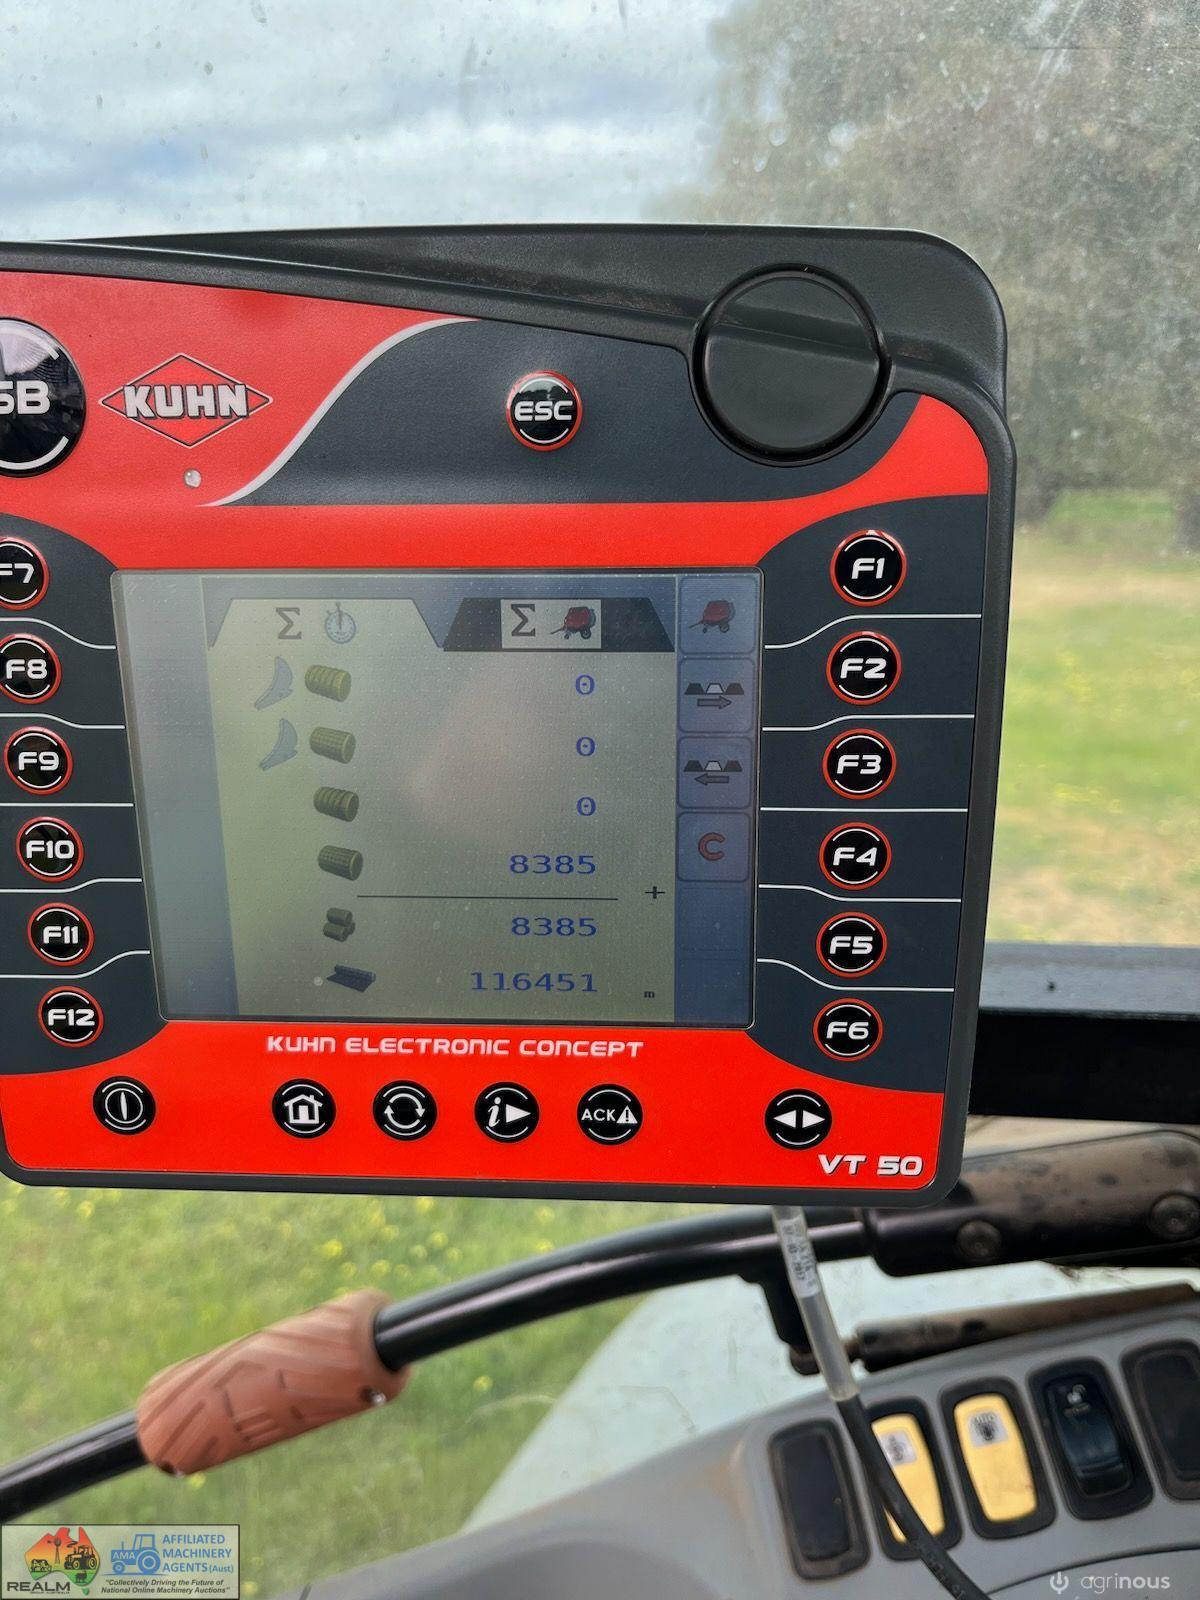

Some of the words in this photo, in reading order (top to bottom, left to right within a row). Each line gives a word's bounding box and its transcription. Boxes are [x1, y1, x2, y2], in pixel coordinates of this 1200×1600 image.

[123, 384, 249, 418] KUHN
[514, 400, 573, 422] ESC
[851, 557, 886, 579] F1
[6, 659, 47, 680] F8
[839, 658, 887, 679] F2
[575, 674, 595, 695] 0
[576, 736, 596, 757] 0
[18, 751, 59, 771] F9
[836, 754, 882, 775] F3
[576, 796, 597, 817] 0
[26, 839, 75, 859] F10
[698, 831, 727, 862] C
[832, 847, 878, 867] F4
[509, 854, 597, 875] 8385
[43, 925, 78, 944] F11
[511, 917, 598, 937] 8385
[829, 935, 874, 955] F5
[470, 971, 598, 992] 116451
[47, 1008, 95, 1026] F12
[826, 1021, 870, 1041] F6
[267, 1036, 336, 1053] KUHN
[345, 1037, 510, 1056] ELECTRONIC
[519, 1039, 644, 1058] CONCEPT
[581, 1107, 616, 1123] ACK
[818, 1154, 866, 1176] VT
[876, 1154, 924, 1177] 50
